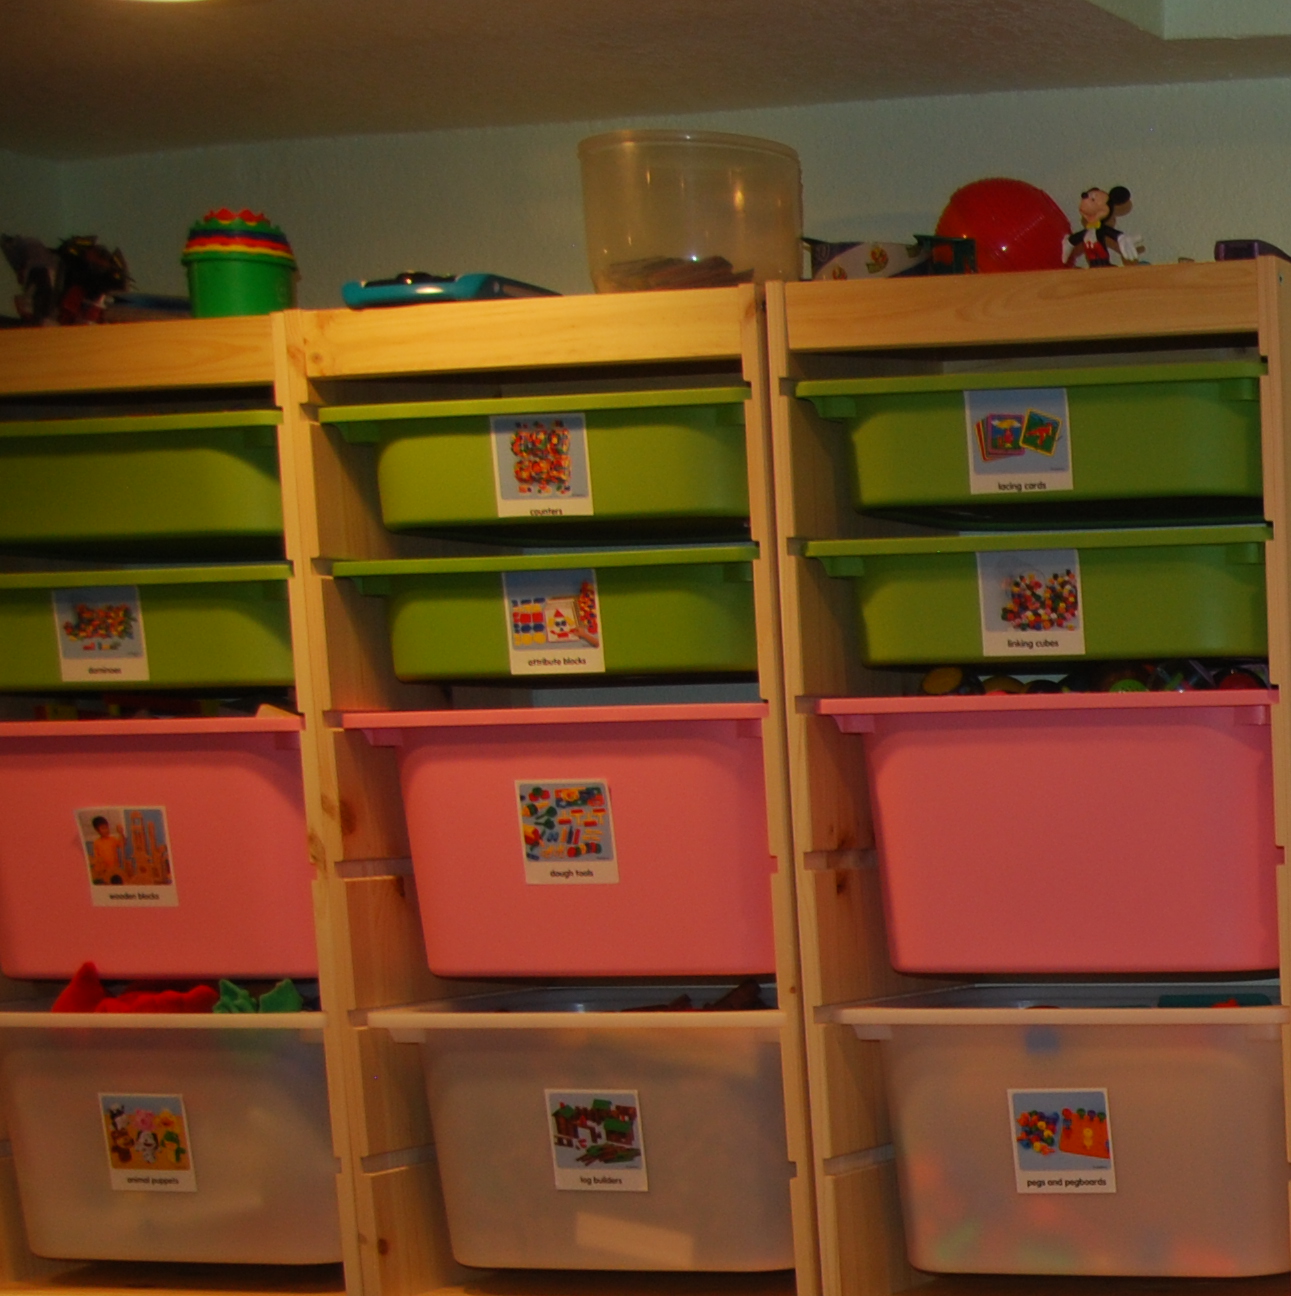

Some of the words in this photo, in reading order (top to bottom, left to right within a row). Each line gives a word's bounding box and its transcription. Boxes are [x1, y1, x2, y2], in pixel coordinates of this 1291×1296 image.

[998, 482, 1022, 491] lacing
[1008, 640, 1033, 648] linking
[529, 658, 561, 666] attribute
[564, 657, 586, 665] blocks
[550, 870, 573, 878] dough
[1027, 1179, 1045, 1187] pegs
[1065, 1179, 1106, 1187] pegboards
